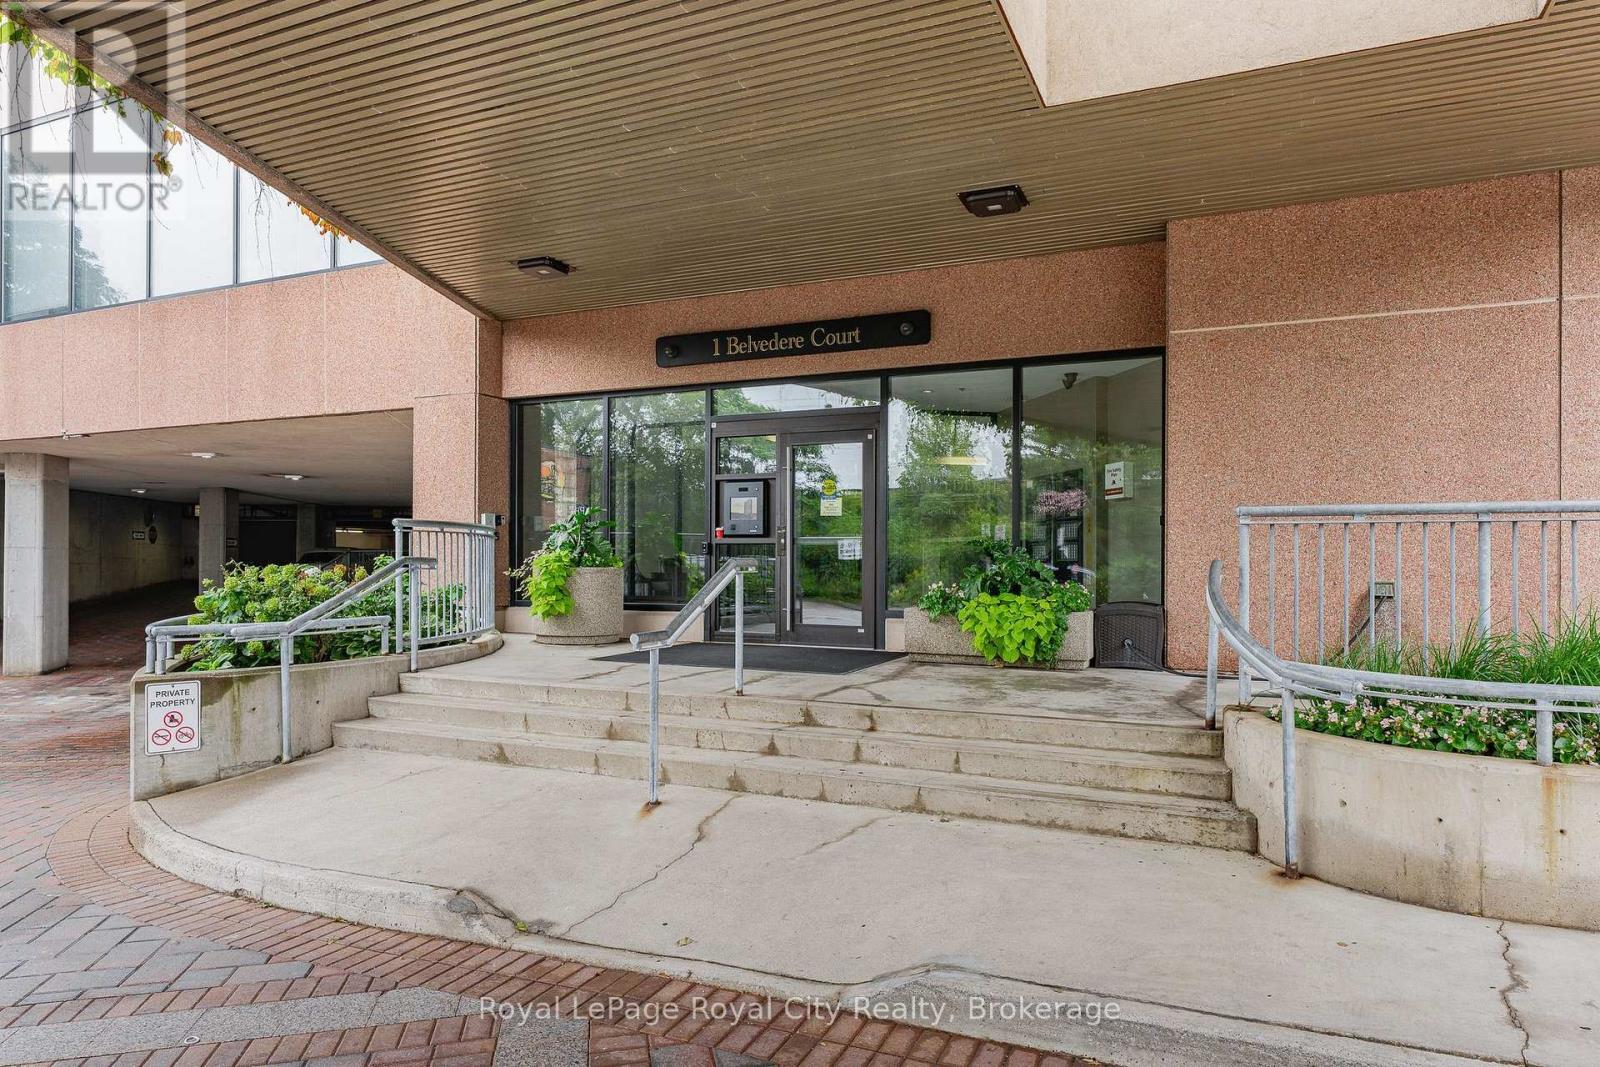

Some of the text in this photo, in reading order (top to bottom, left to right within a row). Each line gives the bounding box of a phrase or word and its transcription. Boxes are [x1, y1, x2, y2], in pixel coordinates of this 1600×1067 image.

[713, 326, 861, 356] 1 Belvedere Court
[155, 689, 190, 697] PRIVATE
[150, 698, 195, 708] PROPERTY
